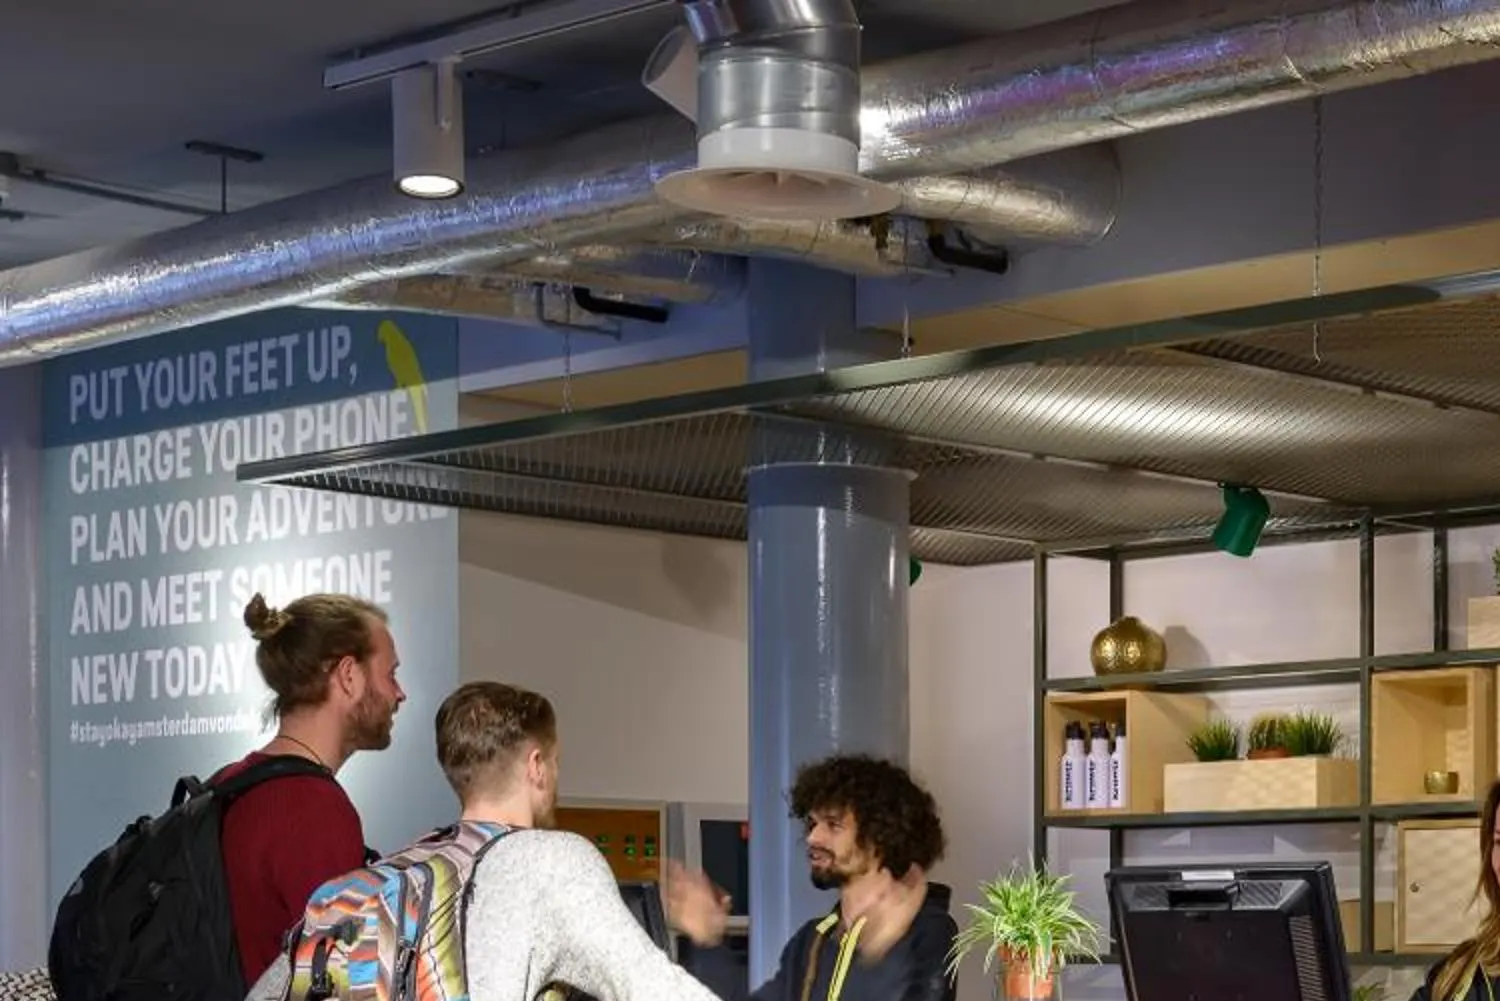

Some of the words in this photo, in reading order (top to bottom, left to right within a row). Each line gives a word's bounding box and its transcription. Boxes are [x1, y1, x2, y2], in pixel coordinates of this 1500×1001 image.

[69, 366, 129, 425] PUT
[134, 350, 219, 413] YOUR
[225, 333, 299, 397] FEET
[307, 325, 358, 385] UP,
[70, 427, 193, 494] CHARGE
[198, 411, 285, 475] YOUR
[71, 507, 147, 566] PLAN
[153, 494, 239, 554] YOUR
[70, 581, 133, 636] AND
[141, 569, 223, 629] MEET
[71, 651, 139, 706] NEW
